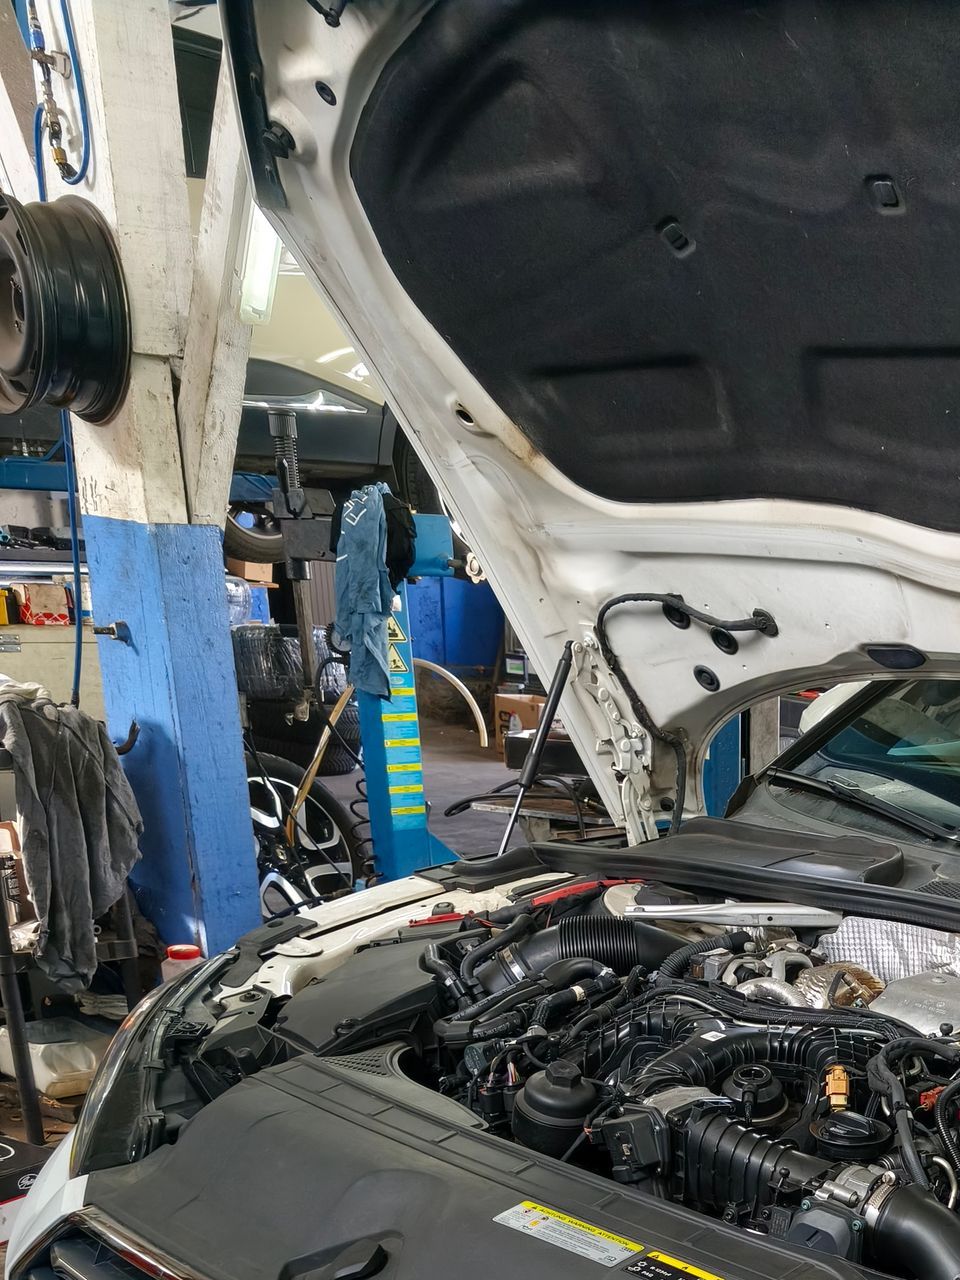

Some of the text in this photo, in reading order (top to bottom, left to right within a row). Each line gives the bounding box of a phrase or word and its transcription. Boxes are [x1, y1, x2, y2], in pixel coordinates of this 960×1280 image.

[539, 1207, 567, 1221] ACHTUNG
[568, 1218, 596, 1233] WARNING
[598, 1230, 630, 1246] ATTENTION
